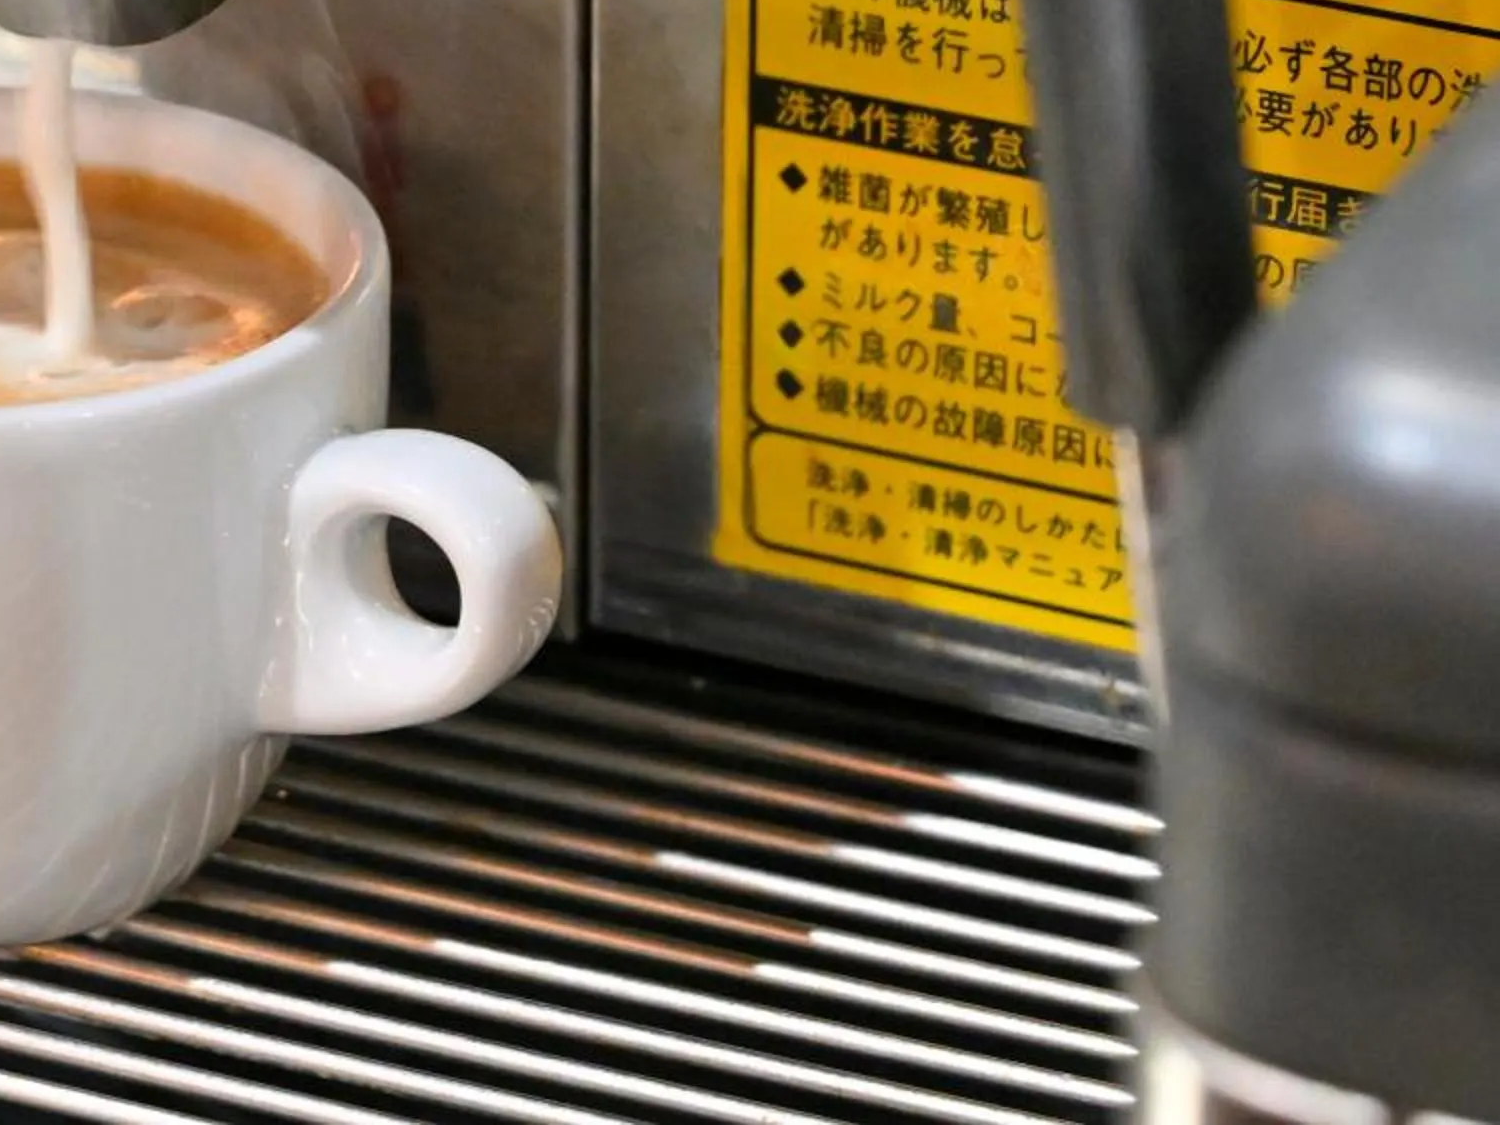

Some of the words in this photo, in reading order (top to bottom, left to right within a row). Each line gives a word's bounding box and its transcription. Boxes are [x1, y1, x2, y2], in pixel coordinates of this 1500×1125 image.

[807, 3, 1030, 80] 清掃を行っ
[1236, 86, 1446, 158] 要があり
[819, 217, 1019, 292] があります。
[816, 317, 1070, 409] 不良の原因に
